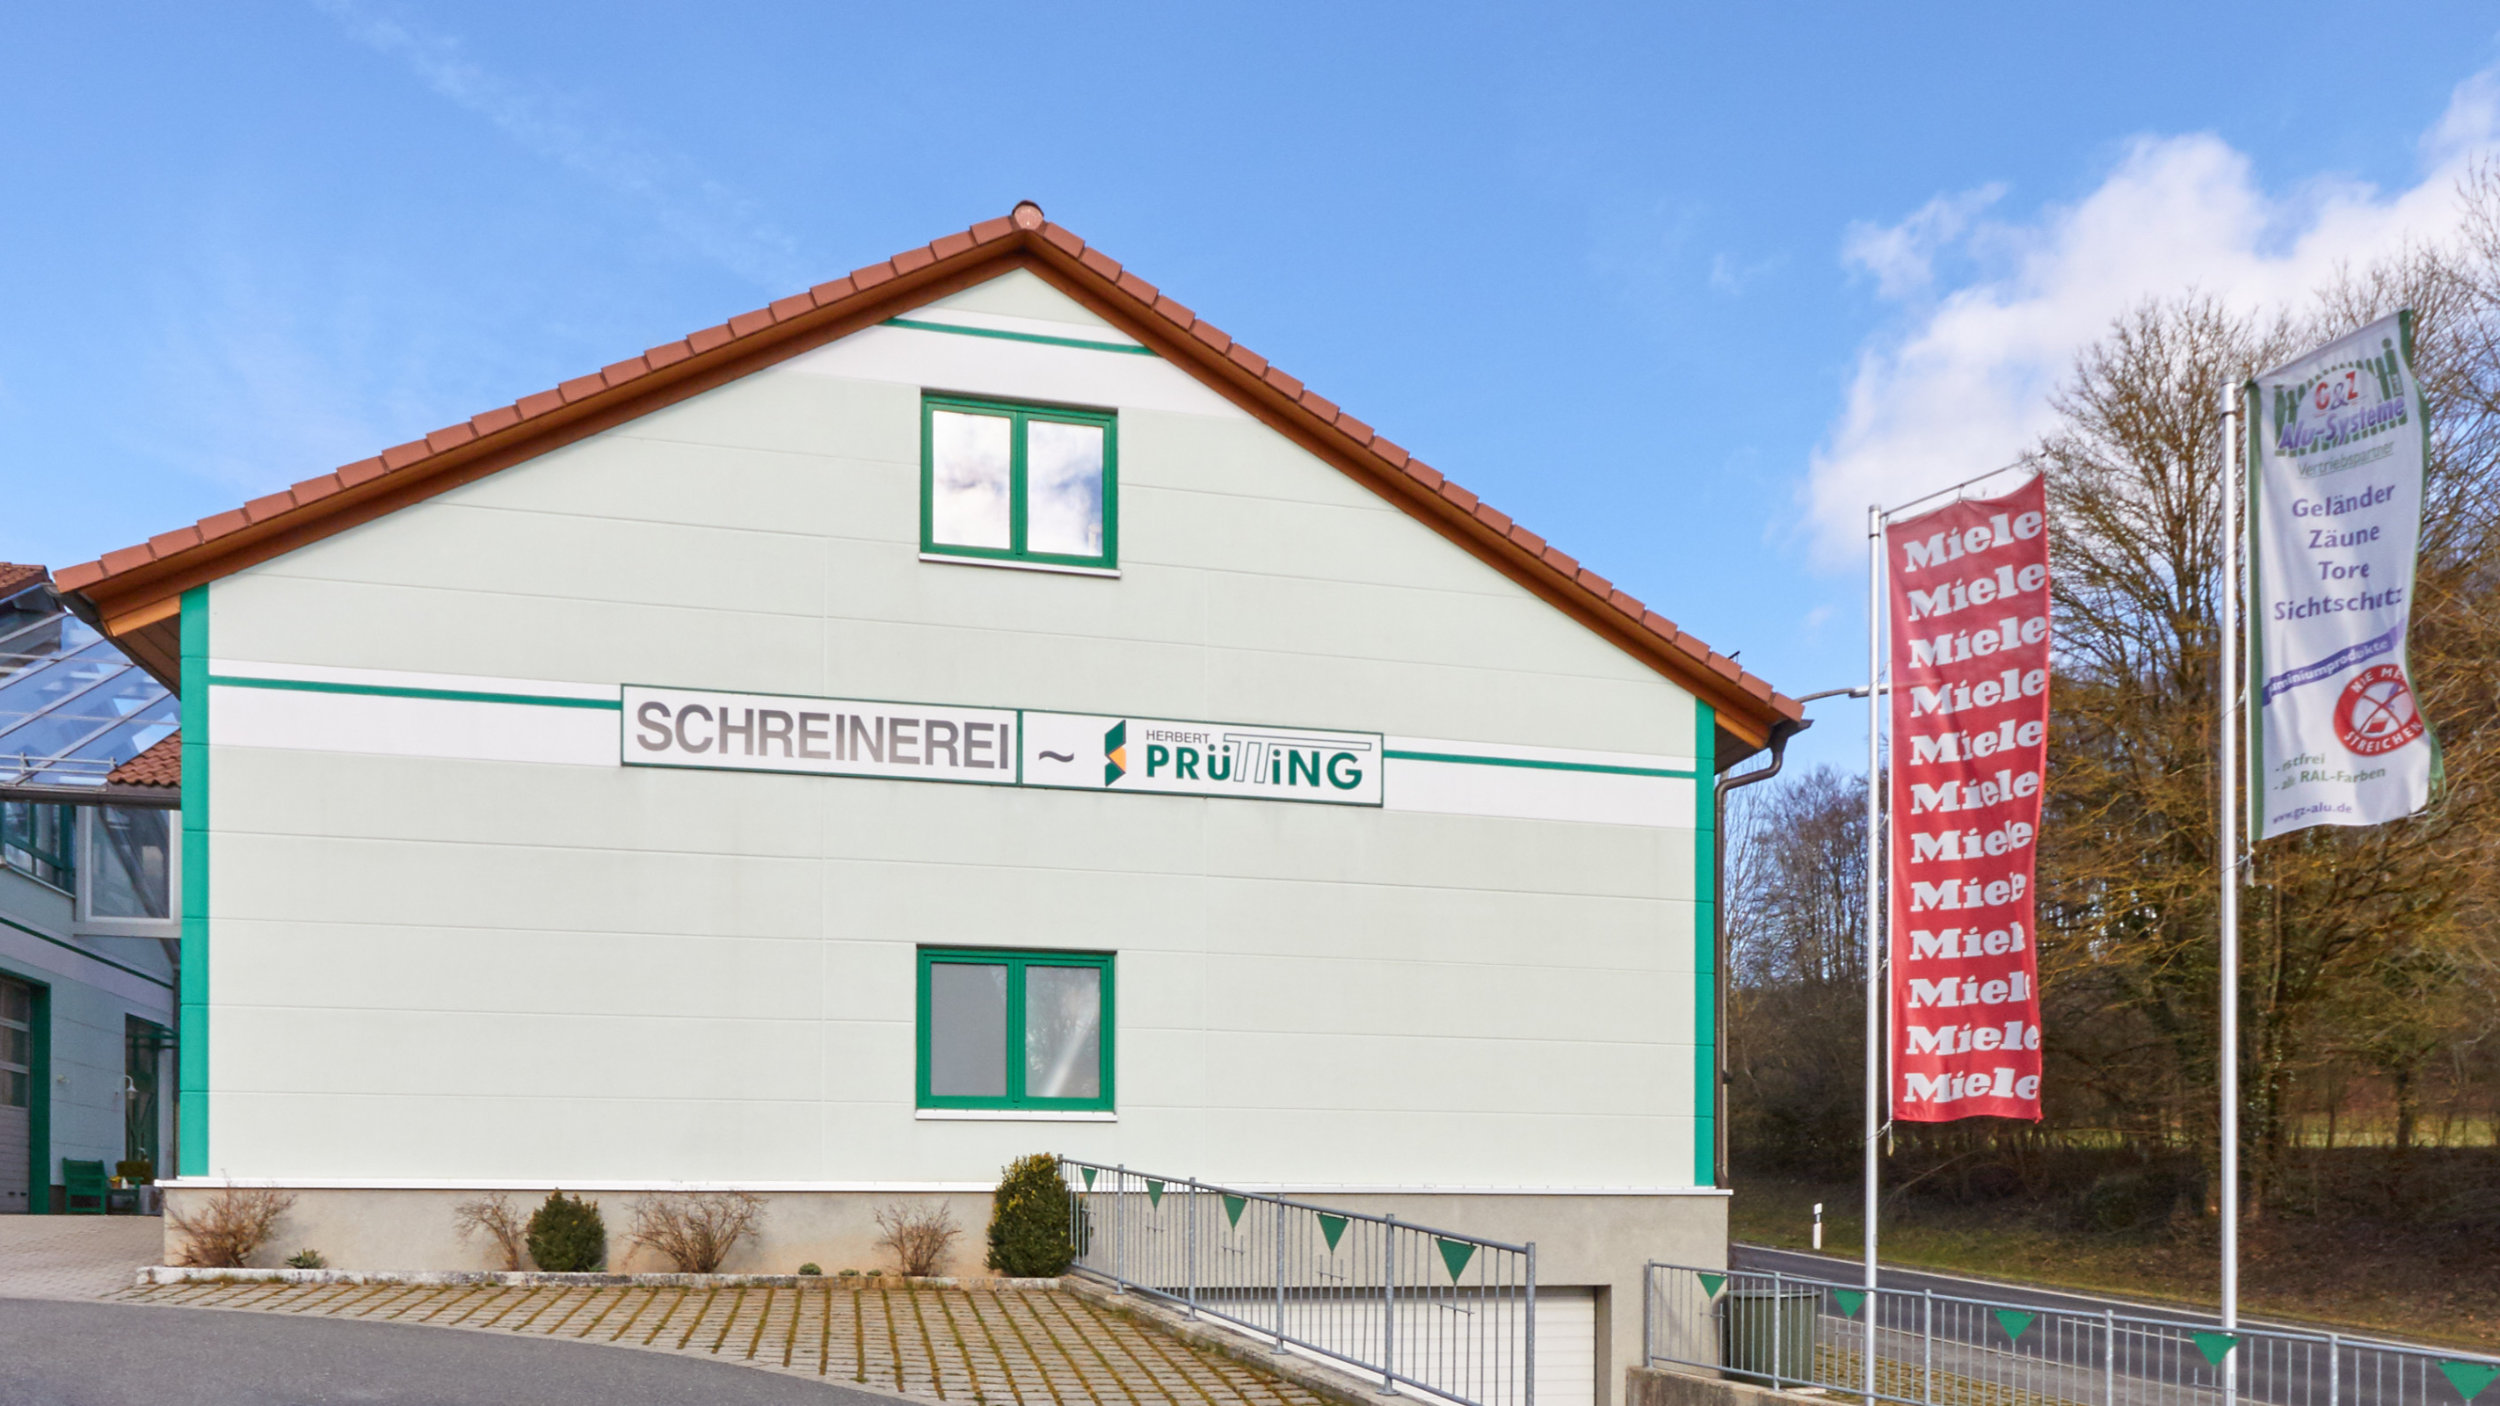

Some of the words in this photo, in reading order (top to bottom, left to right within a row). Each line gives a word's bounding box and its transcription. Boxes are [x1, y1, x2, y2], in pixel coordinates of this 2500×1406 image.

[2279, 397, 2405, 449] Alu-Systeme
[2292, 485, 2396, 518] Geländer
[1903, 510, 2043, 573] Miele
[2308, 525, 2381, 549] Zäune
[2318, 561, 2370, 580] Tore
[1907, 563, 2046, 622] Miele
[1908, 616, 2047, 669] Miele
[1910, 668, 2046, 718] Miele
[2351, 671, 2375, 693] NIE
[636, 701, 1009, 770] SCHREINEREI
[1146, 729, 1211, 745] HERBERT
[1910, 719, 2043, 766] Miele
[2344, 722, 2423, 752] STREICHEN
[1910, 769, 2039, 815] Miele
[2300, 768, 2387, 783] RAL-Farben
[1911, 872, 2027, 912] Miee
[1909, 921, 2026, 960] Miel
[1908, 971, 2031, 1008] Miel
[1903, 1067, 2040, 1103] Miele
